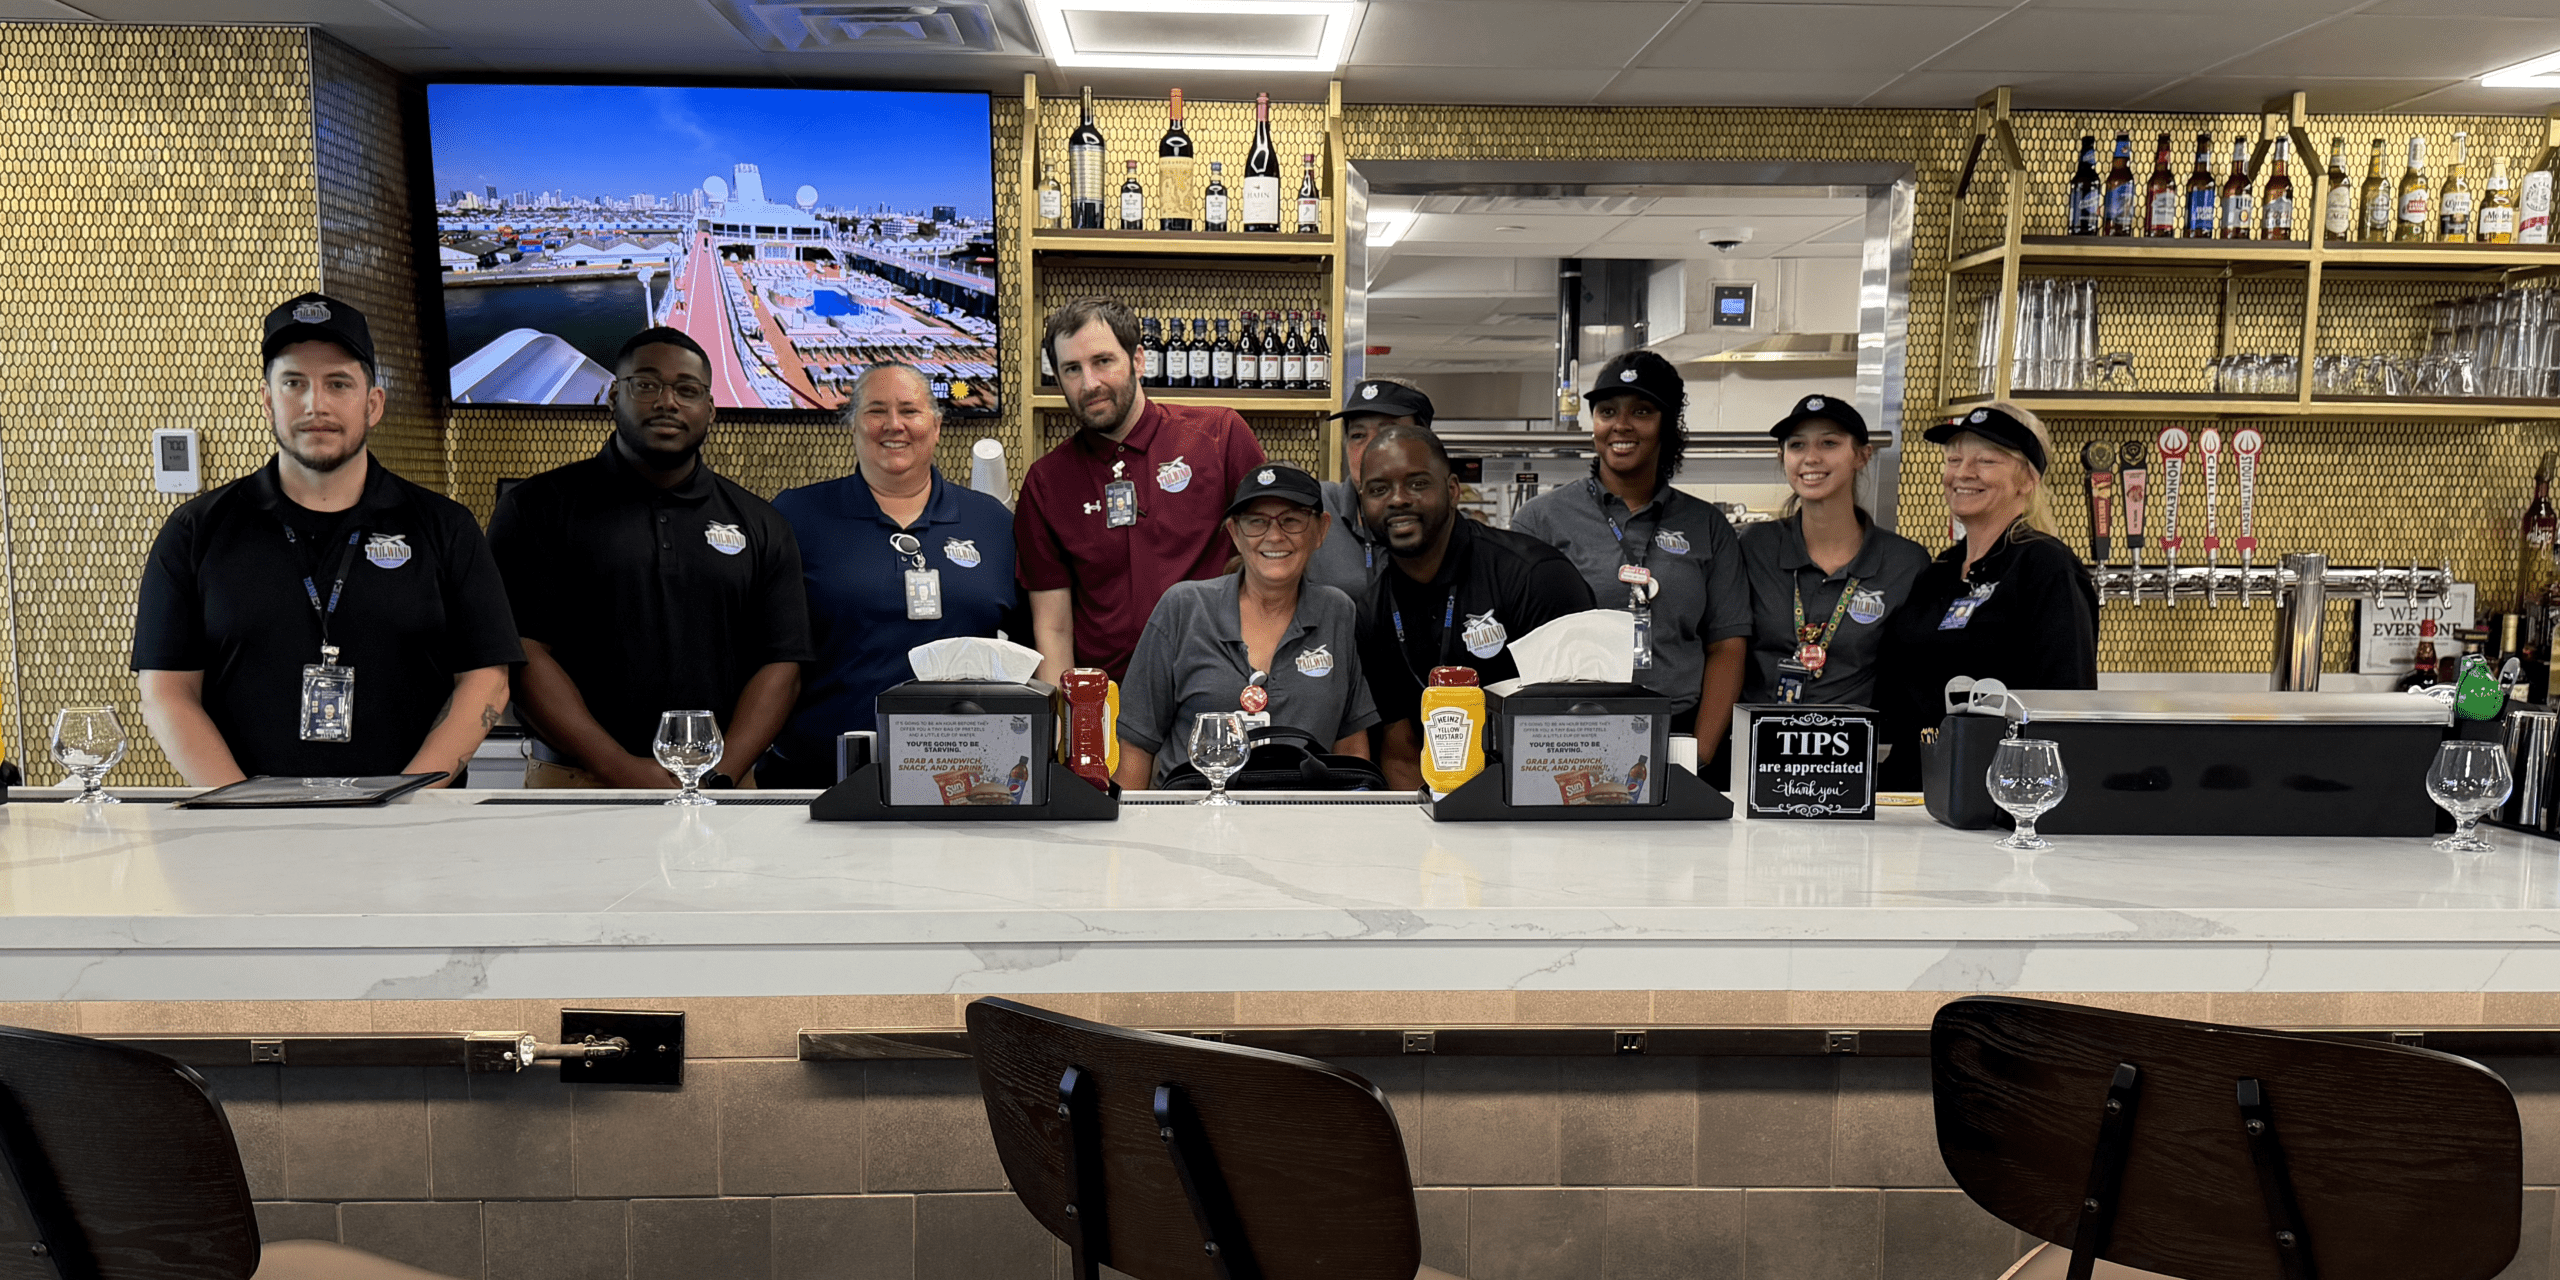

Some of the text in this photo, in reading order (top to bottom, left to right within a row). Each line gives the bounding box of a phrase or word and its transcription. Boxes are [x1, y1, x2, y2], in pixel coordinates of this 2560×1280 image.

[1158, 466, 1190, 488] TAILWIND
[2208, 456, 2216, 498] CHILL
[2241, 456, 2252, 483] STOUT
[2242, 484, 2251, 494] AT
[2166, 460, 2179, 541] MONKEYNAUT
[2242, 496, 2250, 510] THE
[706, 532, 746, 548] TAILWIND
[367, 546, 410, 558] TAILWIND
[945, 546, 981, 562] TAILWIND
[2390, 606, 2444, 620] WE ID
[1462, 624, 1507, 648] TAILWIND
[2372, 623, 2461, 636] EVERN
[1296, 655, 1333, 670] TAILWIND
[1776, 732, 1850, 756] TIPS
[1759, 762, 1864, 776] are appreciated
[945, 781, 965, 796] Sun
[1566, 781, 1584, 796] Sun
[1774, 780, 1848, 803] thank you
